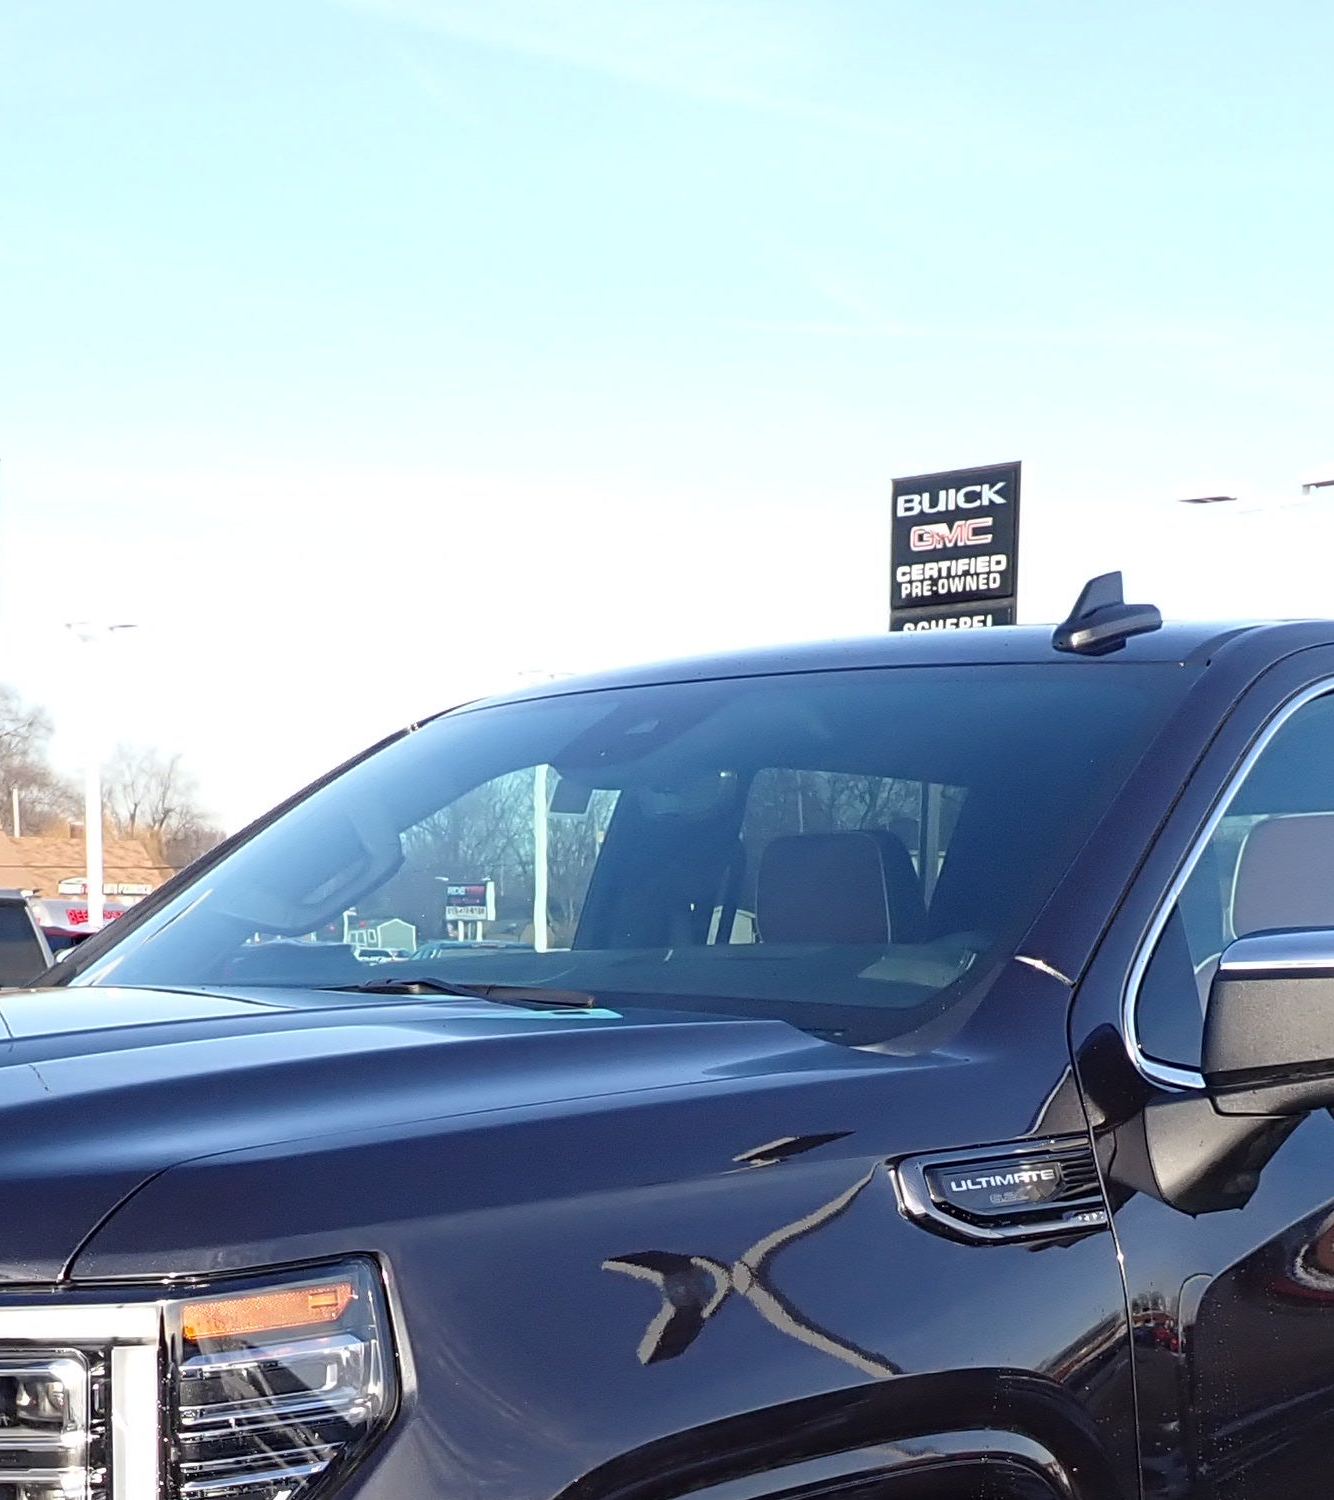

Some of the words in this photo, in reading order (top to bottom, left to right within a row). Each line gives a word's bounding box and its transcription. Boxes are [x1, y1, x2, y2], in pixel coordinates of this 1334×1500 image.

[896, 482, 1007, 517] BUICK
[909, 517, 993, 551] GMC
[896, 554, 1007, 582] CERTIFIED
[901, 572, 1000, 599] PRE-OWNED
[950, 1169, 1056, 1192] ULTIMATE
